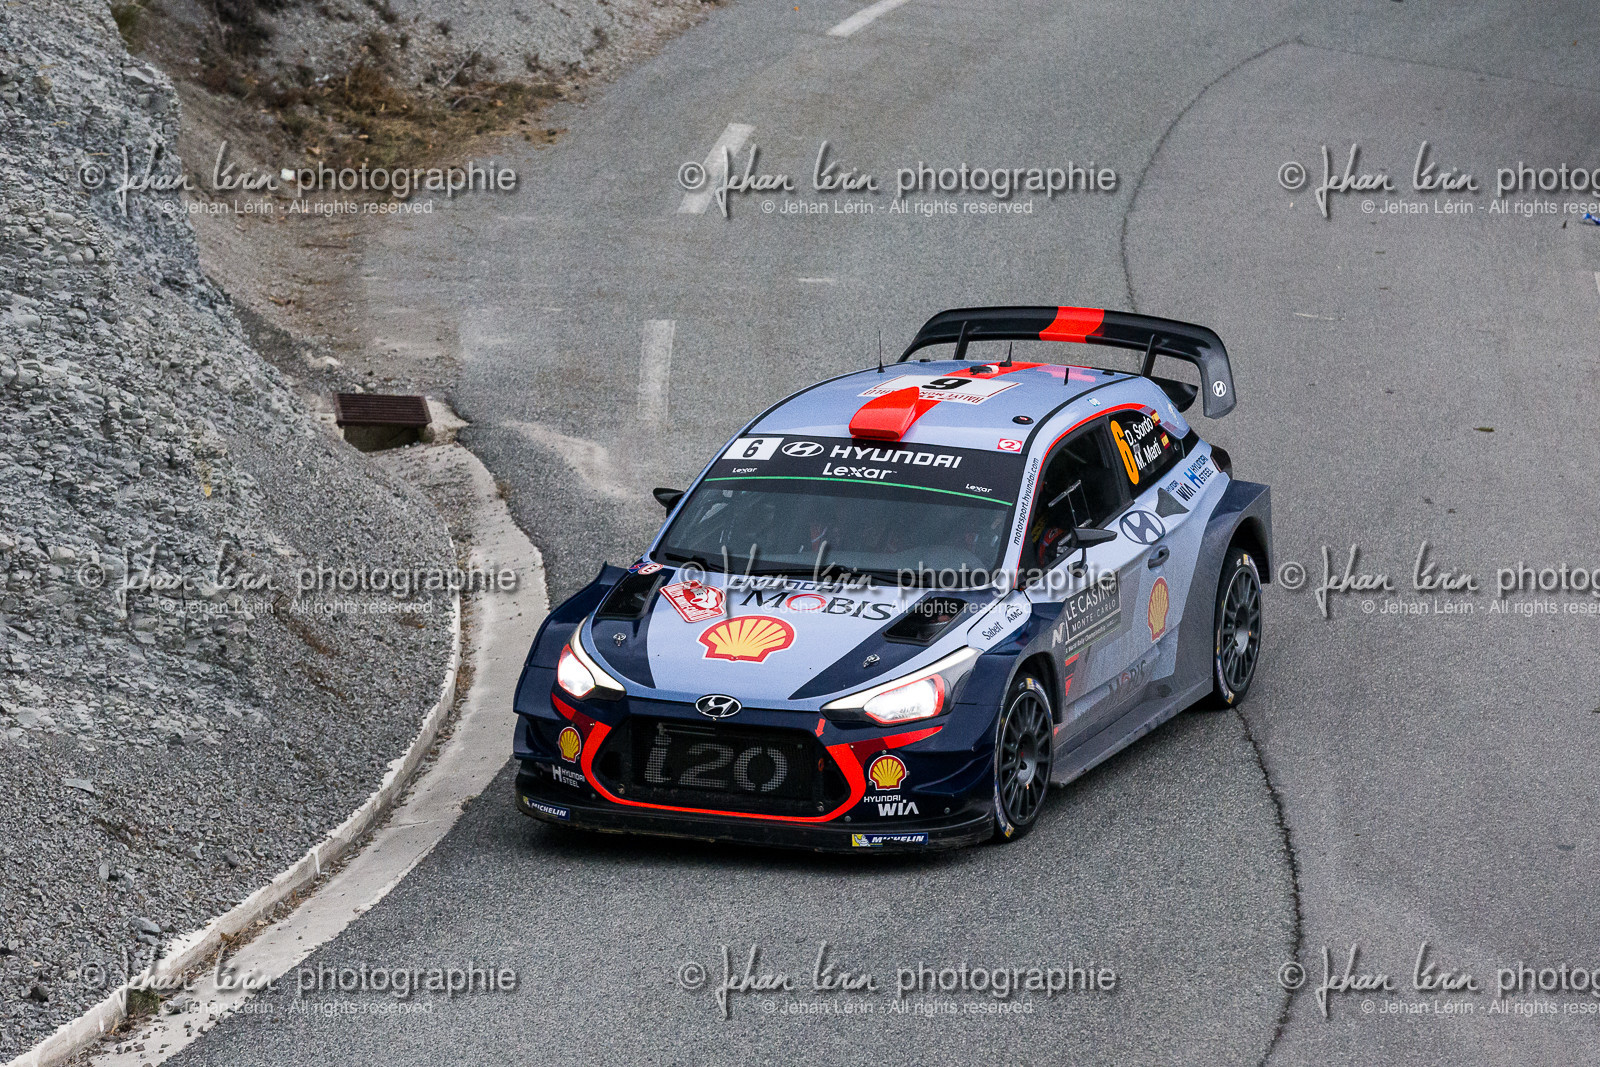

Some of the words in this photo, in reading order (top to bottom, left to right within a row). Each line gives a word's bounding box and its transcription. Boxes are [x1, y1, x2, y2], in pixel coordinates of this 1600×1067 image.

[1124, 429, 1136, 446] D.
[1132, 416, 1154, 440] Sordo
[746, 438, 759, 458] 6
[1004, 440, 1015, 450] 2
[1110, 420, 1140, 485] 6
[829, 444, 962, 469] HYUNDAI
[1134, 452, 1147, 470] M.
[732, 466, 758, 474] Lexar
[822, 462, 893, 480] Lexar
[1198, 467, 1214, 482] STEEL
[966, 483, 992, 493] Lexar
[1013, 456, 1040, 546] motorsport.hyundai.com
[739, 590, 894, 621] MOBIS
[982, 620, 1004, 642] Sabelt
[644, 734, 788, 792] i20
[562, 769, 586, 782] HYUNDAI
[562, 777, 580, 789] STEEL
[531, 802, 567, 817] MICHELIN
[878, 800, 920, 817] WIA
